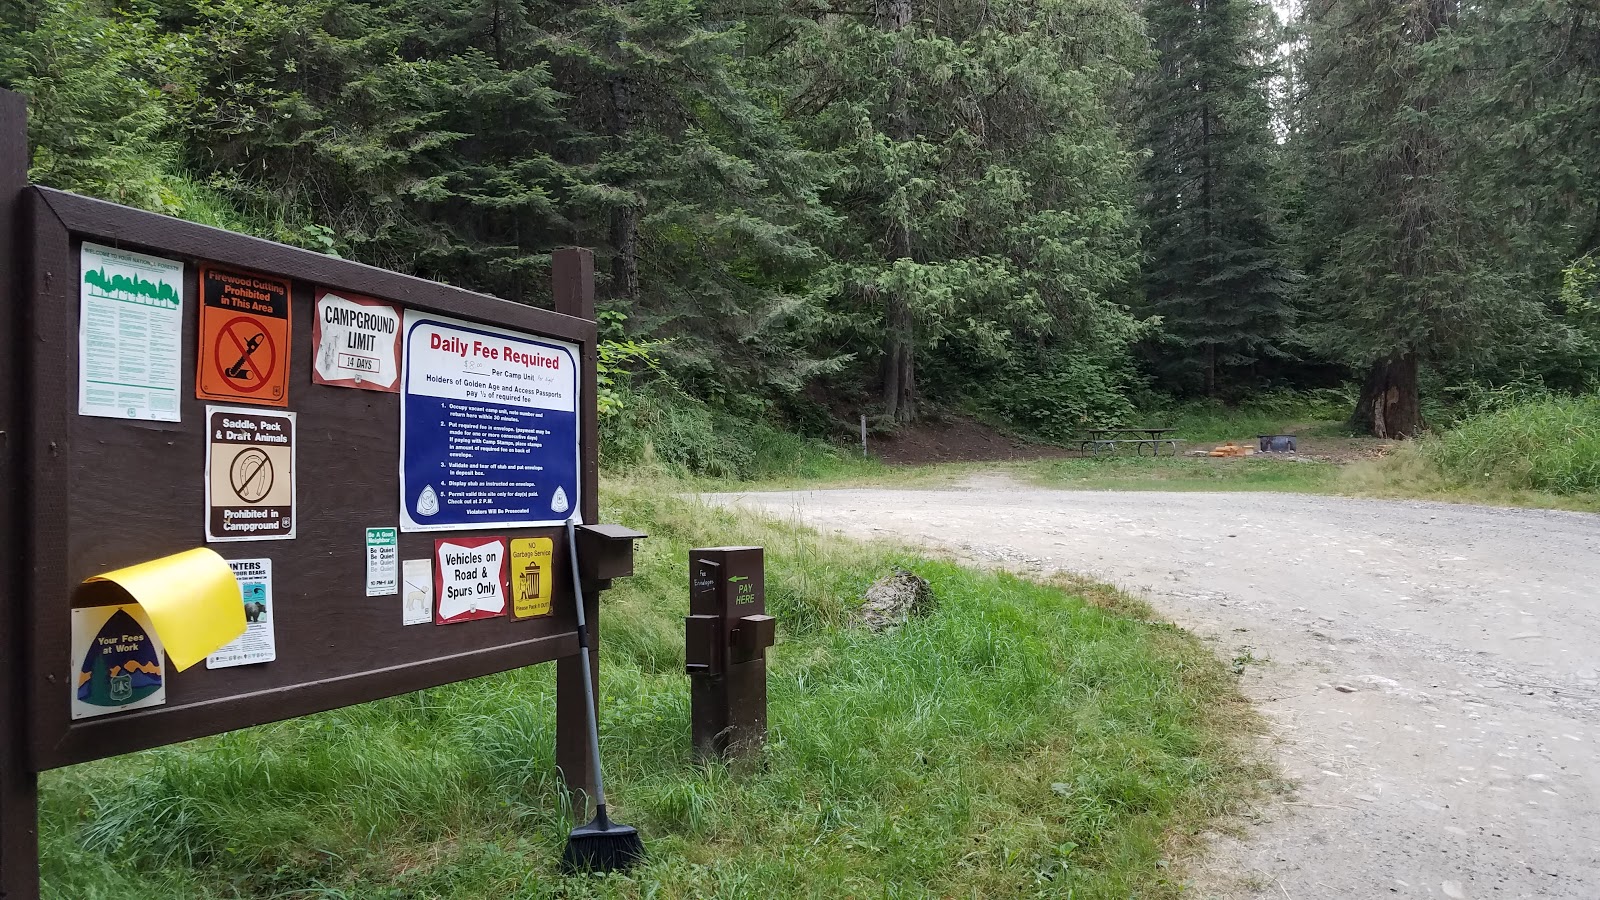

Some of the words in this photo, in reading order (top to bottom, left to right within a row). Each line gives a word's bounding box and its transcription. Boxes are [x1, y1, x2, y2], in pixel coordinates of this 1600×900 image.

[209, 271, 251, 287] Firewood
[252, 280, 284, 295] Cutting
[224, 284, 270, 302] Prohibited
[221, 295, 230, 305] in
[231, 298, 250, 308] This
[252, 302, 273, 313] Area
[325, 306, 395, 334] CAMPGROUND
[348, 331, 376, 352] LIMIT
[430, 333, 468, 358] Daily
[474, 341, 499, 360] Fee
[503, 346, 560, 370] Required
[346, 357, 354, 367] 14
[356, 358, 372, 370] DAYS
[492, 368, 503, 377] Per
[504, 370, 522, 380] Camp
[523, 374, 534, 382] Unit
[426, 374, 454, 385] Holders
[464, 380, 486, 389] Golden
[488, 383, 500, 392] Age
[514, 386, 534, 395] Access
[536, 388, 562, 398] Passports
[466, 390, 478, 398] pay
[496, 393, 520, 402] required
[222, 418, 258, 431] Saddle,
[260, 421, 281, 431] Pack
[216, 430, 222, 439] &
[226, 431, 251, 440] Draft
[255, 433, 288, 442] Animals
[224, 509, 268, 518] Prohibited
[270, 509, 278, 518] in
[224, 521, 280, 532] Campground
[446, 552, 482, 566] Vehicles
[486, 553, 496, 562] on
[513, 551, 533, 559] Garbage
[454, 568, 478, 581] Road
[482, 566, 488, 578] &
[448, 586, 472, 600] Spurs
[476, 582, 496, 595] Only
[739, 584, 753, 593] PAY
[736, 594, 754, 605] HERE
[98, 637, 118, 646] Your
[122, 635, 144, 643] Fees
[103, 646, 112, 655] at
[116, 644, 138, 653] Work
